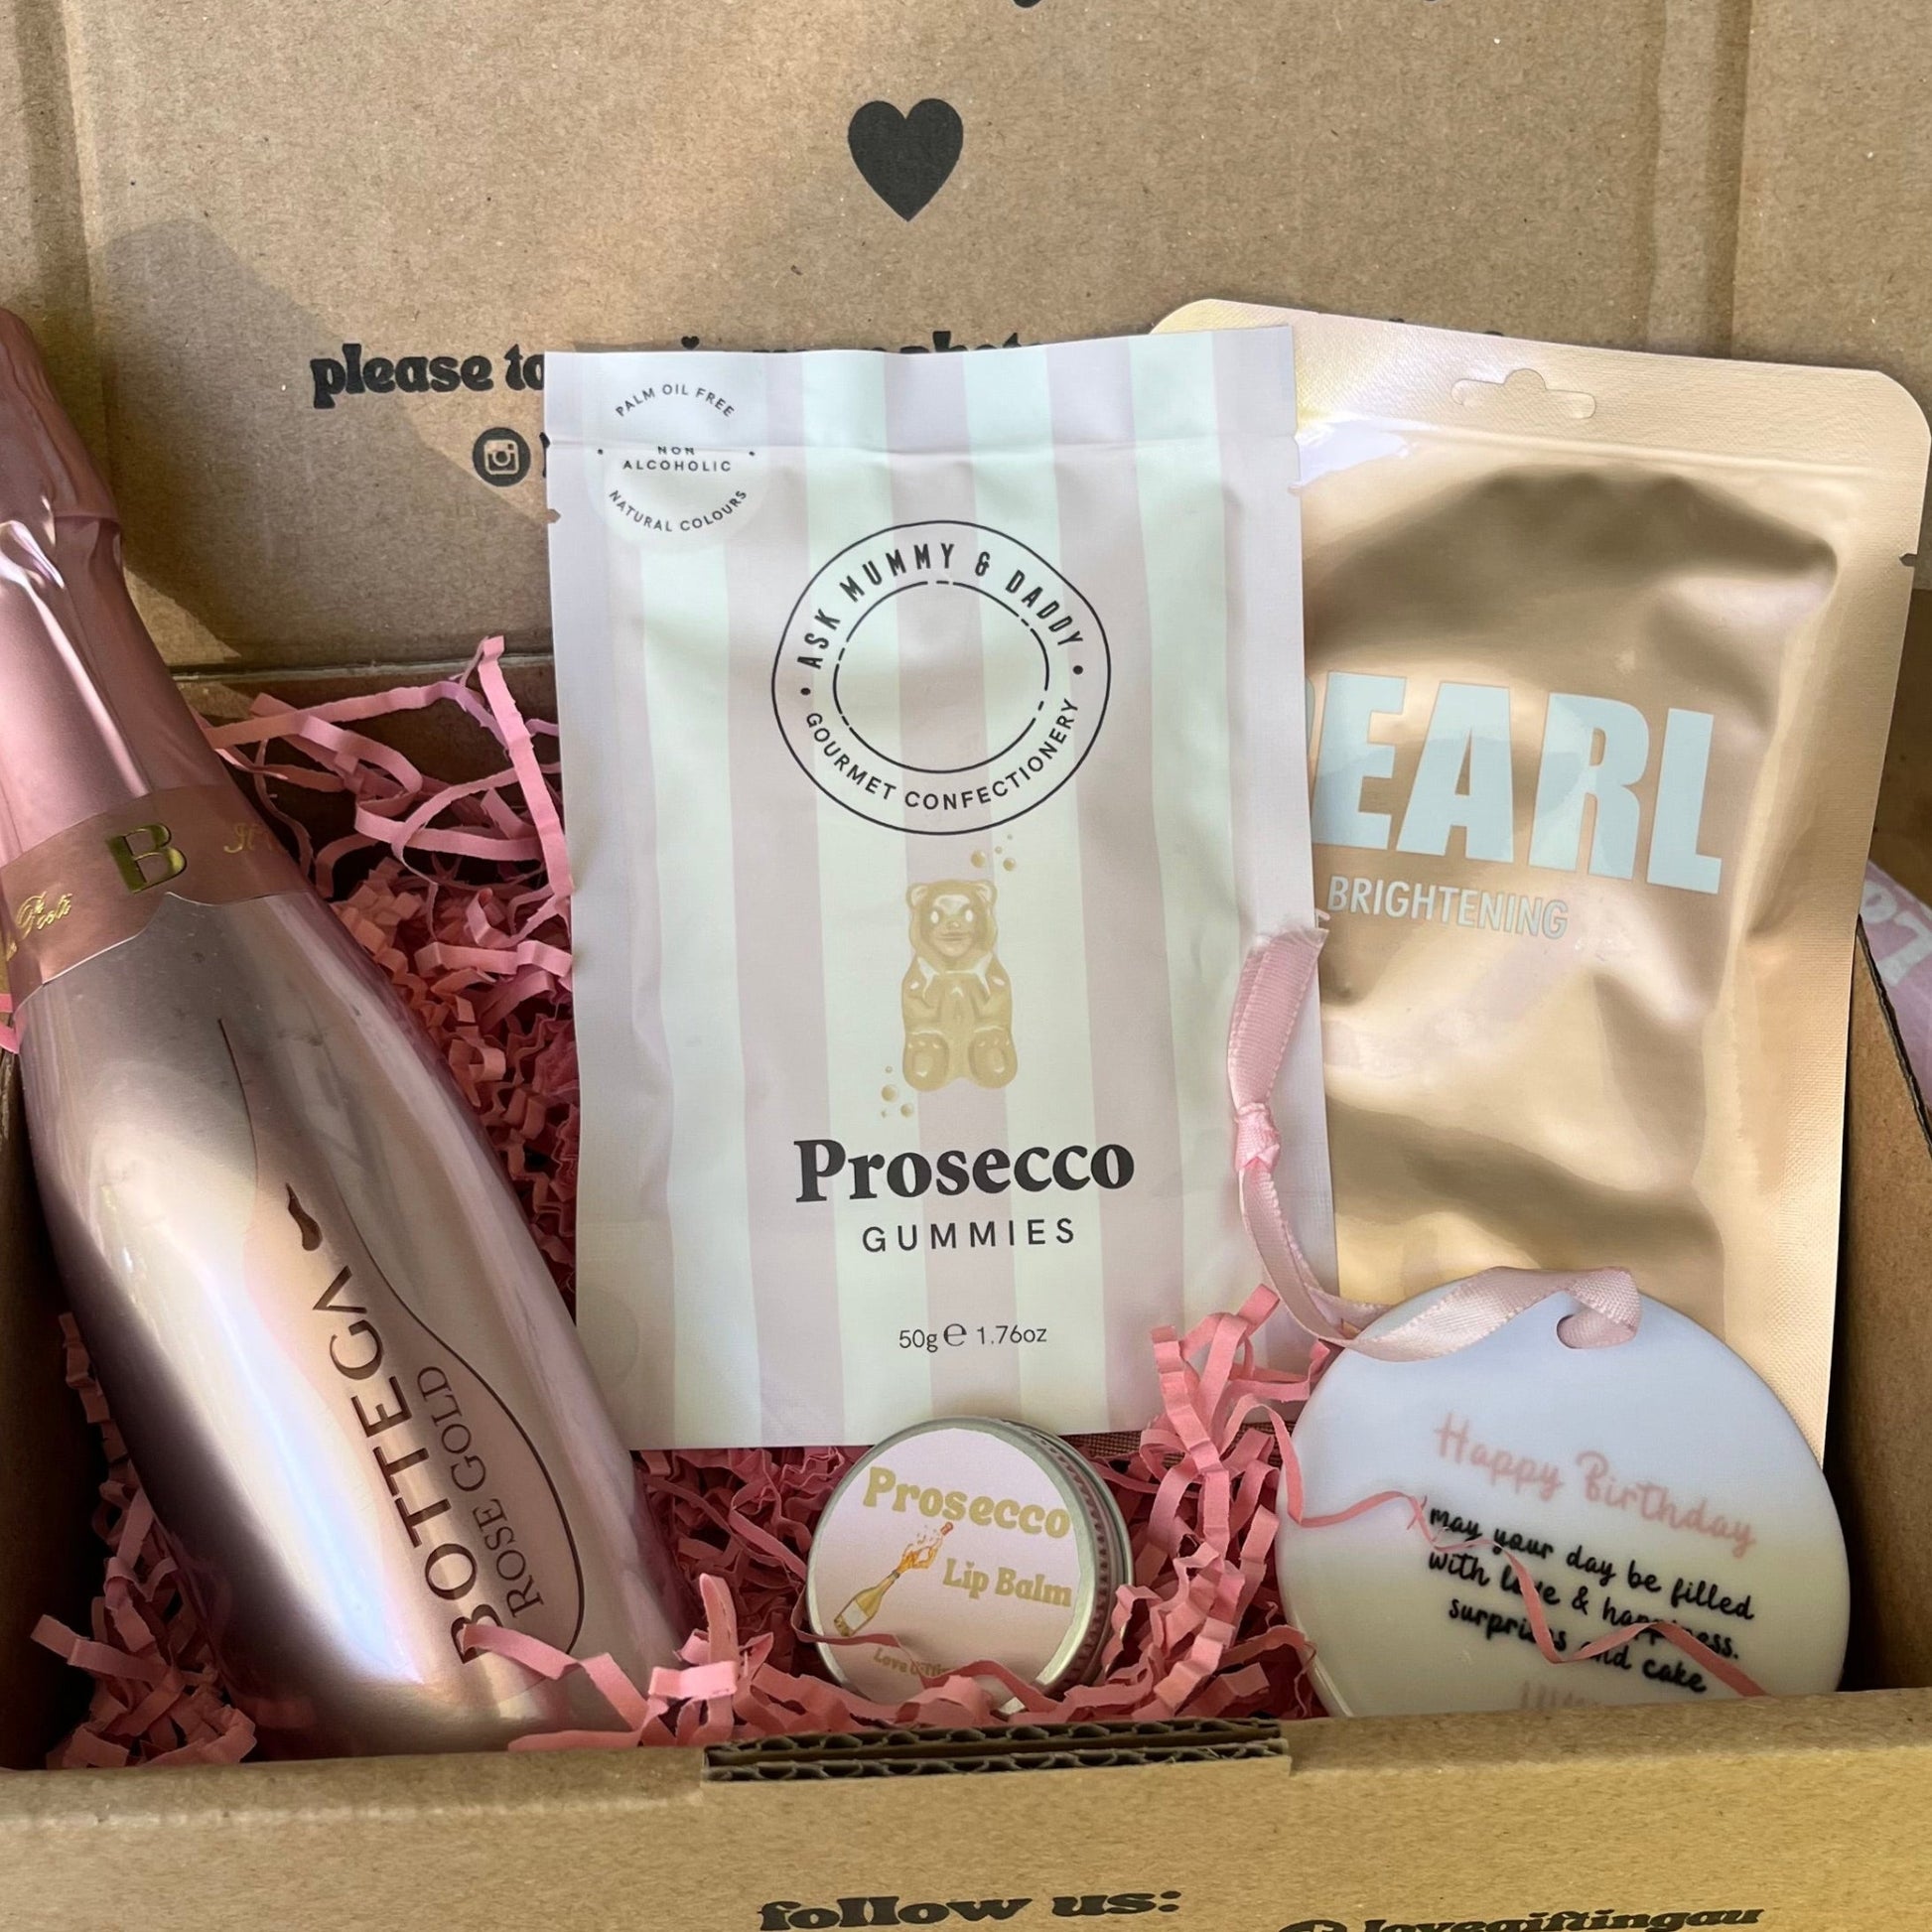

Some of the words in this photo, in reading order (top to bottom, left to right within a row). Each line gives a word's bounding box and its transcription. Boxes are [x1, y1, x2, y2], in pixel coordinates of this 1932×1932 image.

[310, 344, 493, 409] please
[615, 387, 655, 417] PALM
[662, 383, 689, 396] OIL
[695, 387, 735, 417] FREE
[622, 460, 732, 472] ALCOHOLIC
[657, 445, 695, 456] NON
[609, 489, 673, 532] NATURAL
[679, 490, 748, 532] COLOURS
[797, 609, 841, 670] ASK
[839, 543, 955, 603] MUMMY
[974, 551, 991, 577] &
[1005, 570, 1083, 647] DADDY
[805, 713, 897, 800] GOURMET
[903, 698, 1079, 810] CONFECTIONERY
[1305, 670, 1723, 895] EARL
[1326, 875, 1570, 940] BRIGHTENING
[793, 1139, 1136, 1203] Prosecco
[862, 1218, 1075, 1253] GUMMIES
[897, 1329, 938, 1353] 50g
[977, 1324, 1047, 1345] 1.76oz
[416, 1365, 487, 1492] GOLD
[313, 1265, 504, 1665] BOTTEGA
[1434, 1412, 1565, 1502] Happy
[1576, 1450, 1757, 1560] Birthday
[863, 1466, 1071, 1539] Prosecco
[472, 1498, 545, 1618] ROSE
[942, 1558, 990, 1600] Lip
[995, 1567, 1072, 1608] Balm
[1428, 1552, 1491, 1587] with
[1572, 1586, 1590, 1615] &
[1430, 1508, 1483, 1548] may
[1492, 1528, 1555, 1559] your
[1566, 1545, 1616, 1587] day
[1627, 1560, 1662, 1593] be
[1670, 1578, 1755, 1620] filled
[1642, 1657, 1708, 1694] cake
[757, 1896, 1034, 1931] follow
[1050, 1890, 1182, 1917] us:
